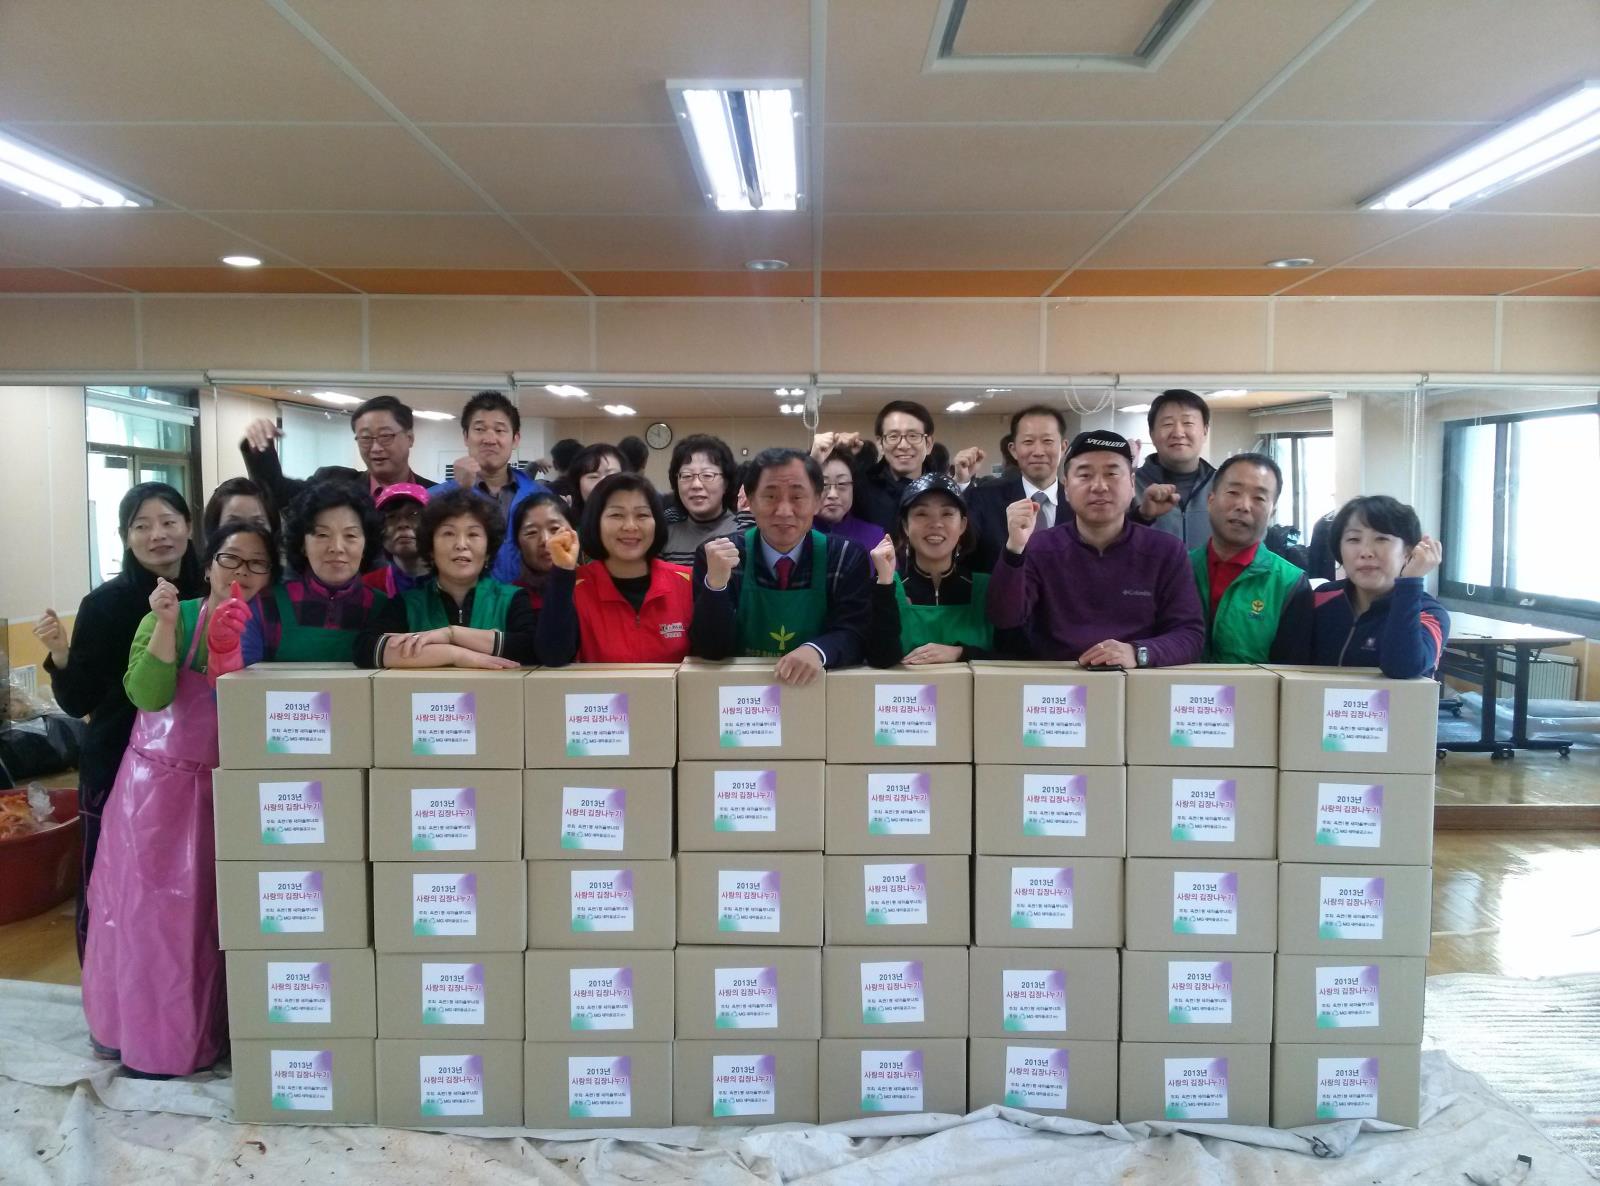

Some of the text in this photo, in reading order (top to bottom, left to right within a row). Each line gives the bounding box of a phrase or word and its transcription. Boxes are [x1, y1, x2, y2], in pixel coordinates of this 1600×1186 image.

[1086, 438, 1126, 448] SPECIALIZED
[737, 697, 761, 705] 2013년
[285, 703, 310, 711] 2013년
[431, 704, 455, 712] 2013년
[584, 705, 608, 713] 2013년
[722, 706, 778, 715] 사랑의 김장나누기
[878, 705, 934, 713] 사랑의 김장나누기
[1026, 706, 1083, 714] 사랑의 김장나누기
[1174, 706, 1232, 714] 사랑의 김장나누기
[293, 713, 328, 721] 김장나누기
[415, 713, 473, 722] 사랑의 김장나누기
[569, 714, 626, 723] 사랑의 김장나누기
[1327, 710, 1386, 719] 사랑의 김장나누기
[733, 782, 756, 790] 2013년
[1042, 786, 1066, 794] 2013년
[278, 793, 302, 802] 2013년
[718, 791, 773, 799] 사랑의 김장나누기
[872, 793, 927, 802] 사랑의 김장나누기
[1027, 795, 1083, 803] 사랑의 김장나누기
[430, 800, 455, 808] 2013년
[1175, 800, 1233, 808] 사랑의 김장나누기
[1337, 796, 1362, 804] 2013년
[263, 802, 320, 812] 사랑의 김장나누기
[1321, 804, 1379, 814] 사랑의 김장나누기
[415, 808, 473, 818] 사랑의 김장나누기
[565, 808, 622, 818] 사랑의 김장나누기
[883, 875, 906, 883] 2013년
[278, 883, 302, 891] 2013년
[432, 885, 456, 893] 2013년
[737, 882, 760, 890] 2013년
[868, 883, 923, 893] 사랑의 김장나누기
[263, 891, 320, 901] 사랑의 김장나누기
[575, 890, 630, 899] 사랑의 김장나누기
[722, 891, 777, 899] 사랑의 김장나누기
[1015, 888, 1070, 896] 사랑의 김장나누기
[416, 894, 473, 903] 사랑의 김장나누기
[1177, 893, 1234, 901] 사랑의 김장나누기
[1323, 898, 1381, 906] 사랑의 김장나누기
[879, 973, 903, 981] 2013년
[1187, 973, 1211, 981] 2013년
[589, 980, 612, 988] 2013년
[733, 979, 757, 987] 2013년
[1022, 981, 1045, 989] 2013년
[1172, 982, 1229, 990] 사랑의 김장나누기
[1335, 978, 1358, 986] 2013년
[271, 982, 327, 991] 사랑의 김장나누기
[425, 984, 481, 992] 사랑의 김장나누기
[865, 981, 920, 992] 사랑의 김장나누기
[574, 988, 630, 998] 사랑의 김장나누기
[718, 987, 774, 997] 사랑의 김장나누기
[1006, 990, 1063, 999] 사랑의 김장나누기
[1319, 986, 1376, 996] 사랑의 김장나누기
[1025, 1059, 1048, 1067] 2013년
[274, 1070, 294, 1078] 사랑의
[439, 1066, 462, 1074] 2013년
[587, 1068, 610, 1076] 2013년
[731, 1066, 755, 1074] 2013년
[1009, 1067, 1065, 1077] 사랑의 김장나누기
[1183, 1069, 1207, 1077] 2013년
[1336, 1069, 1359, 1077] 2013년
[716, 1074, 772, 1083] 사랑의 김장나누기
[865, 1071, 920, 1079] 사랑의 김장나누기
[424, 1075, 480, 1084] 사랑의 김장나누기
[572, 1076, 628, 1085] 사랑의 김장나누기
[1168, 1078, 1225, 1087] 사랑의 김장나누기
[1320, 1078, 1376, 1087] 사랑의 김장나누기
